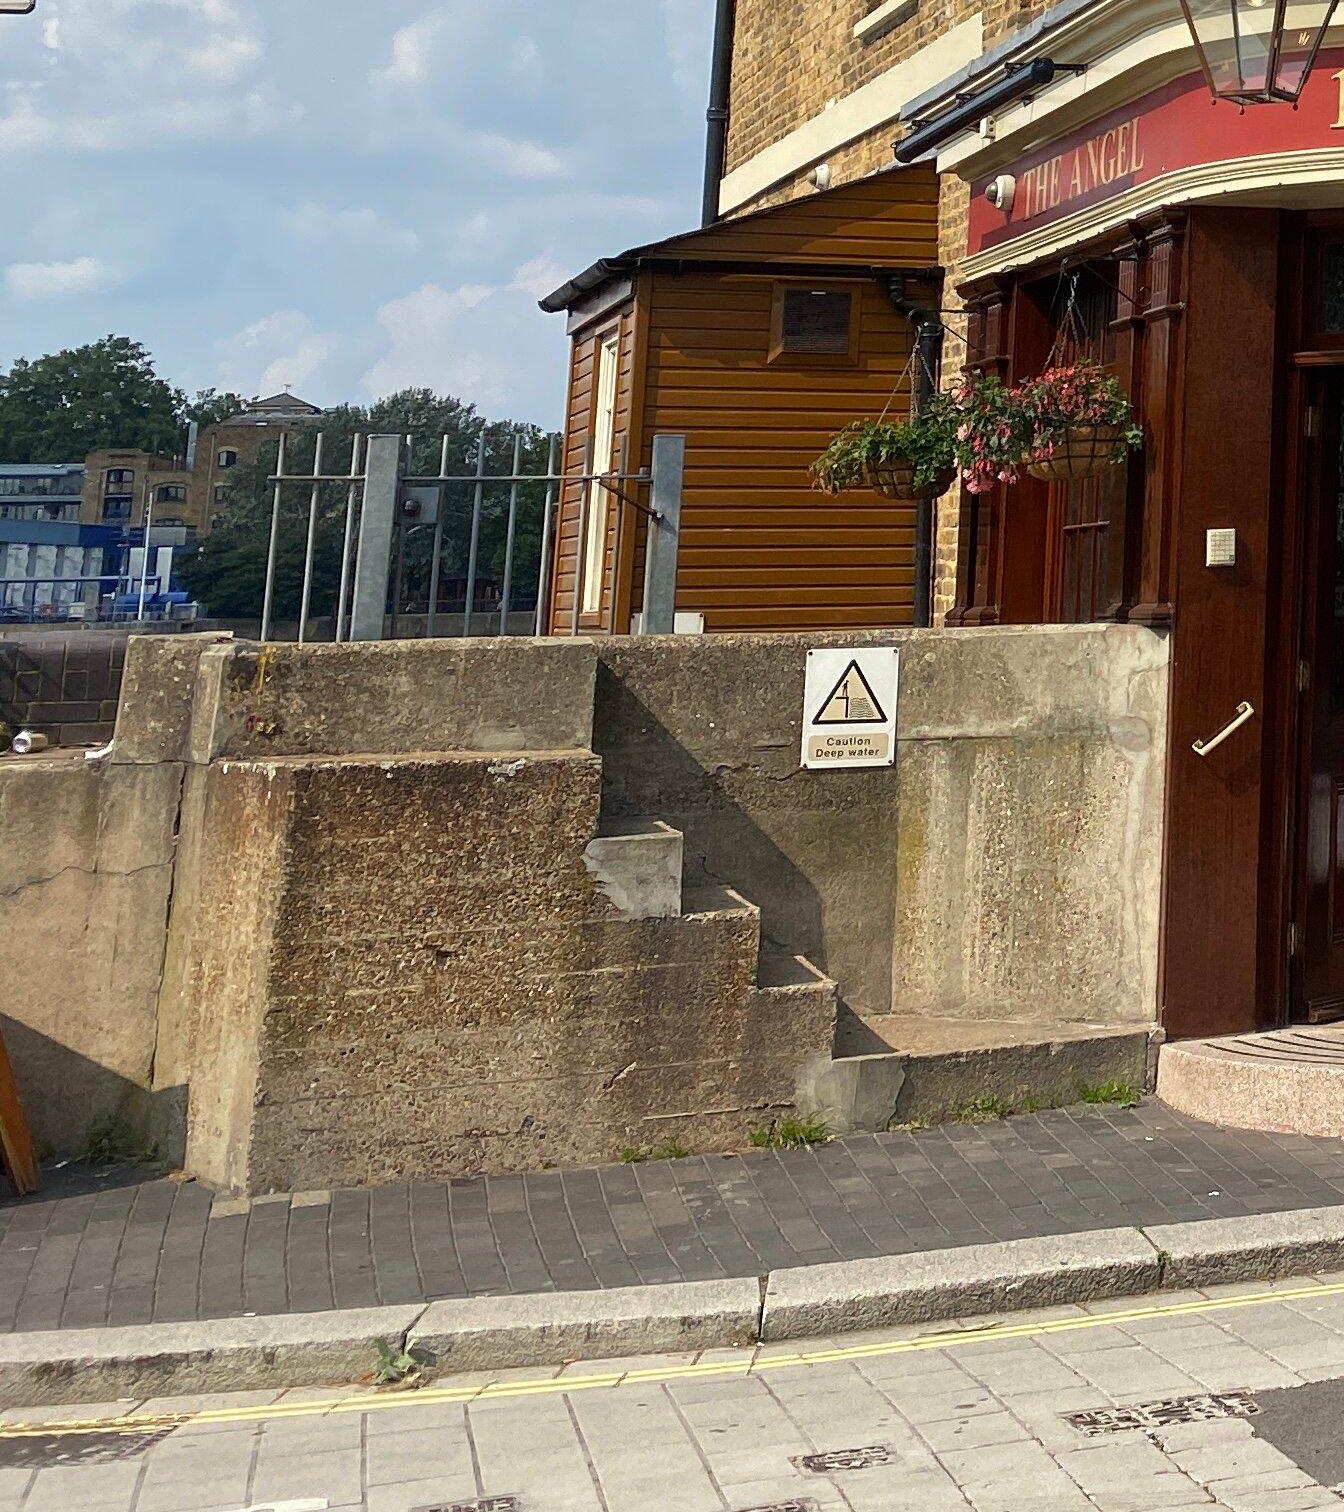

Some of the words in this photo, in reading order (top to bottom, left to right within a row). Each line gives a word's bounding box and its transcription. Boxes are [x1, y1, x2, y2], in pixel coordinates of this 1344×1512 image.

[1023, 154, 1063, 220] THE
[1068, 116, 1145, 201] ANGEL
[826, 736, 871, 747] Caution
[815, 748, 844, 759] Deep
[848, 747, 880, 757] water
